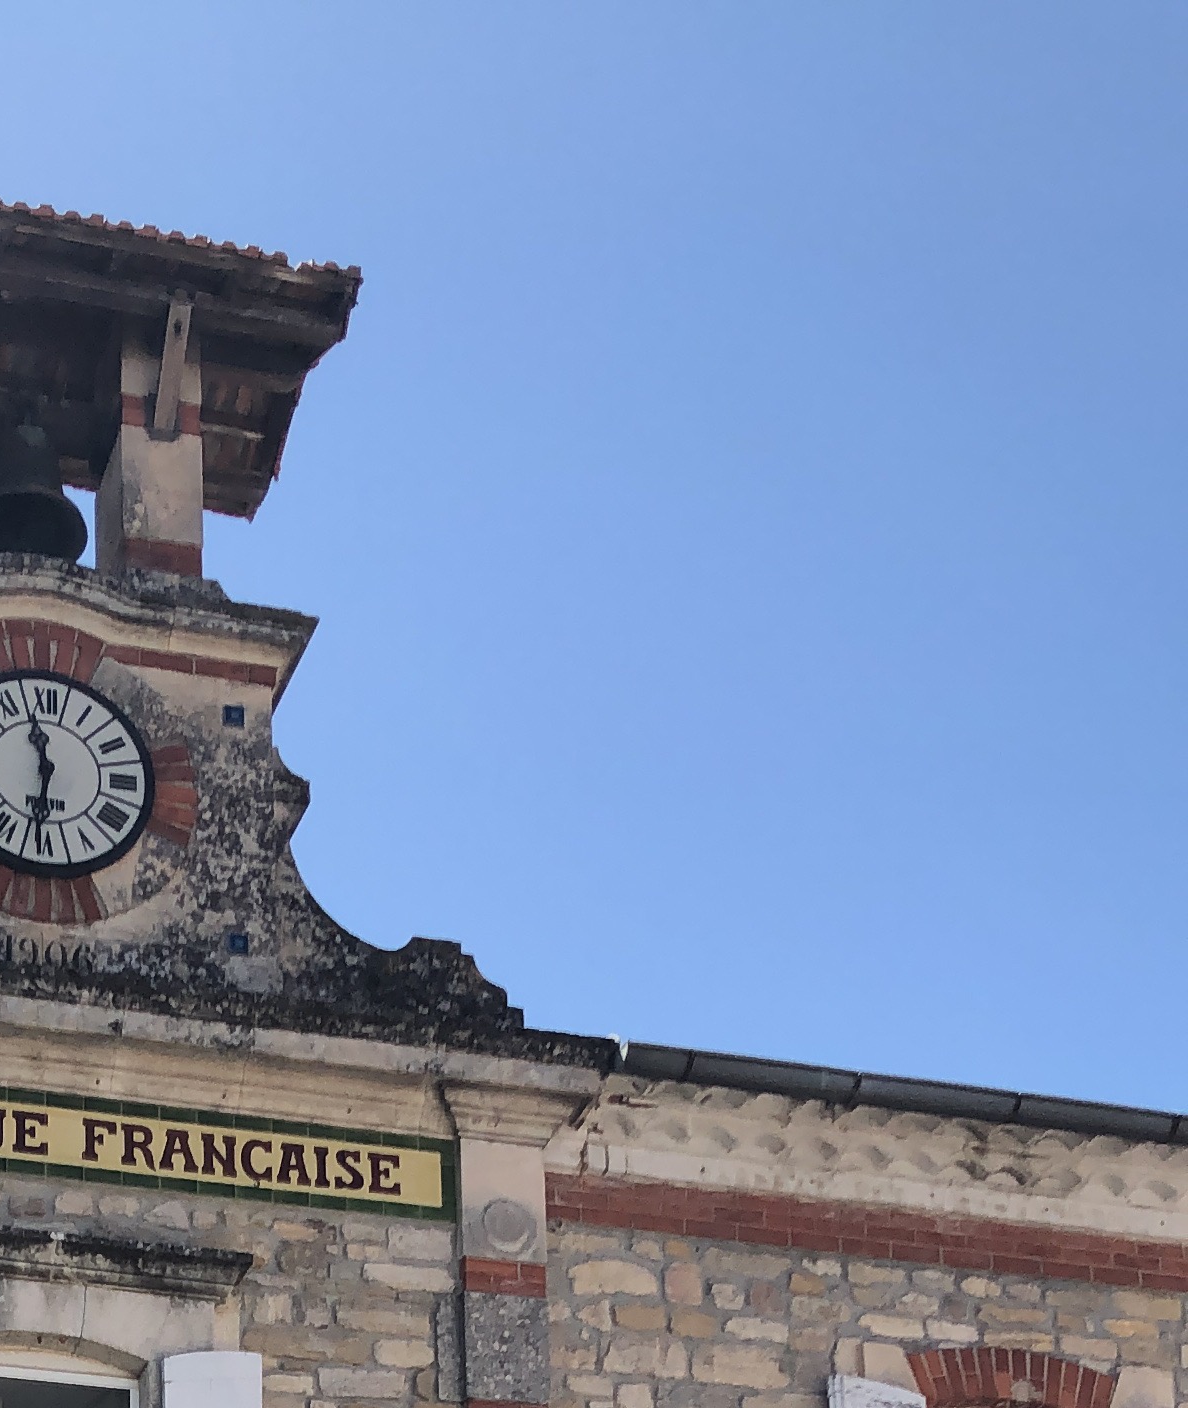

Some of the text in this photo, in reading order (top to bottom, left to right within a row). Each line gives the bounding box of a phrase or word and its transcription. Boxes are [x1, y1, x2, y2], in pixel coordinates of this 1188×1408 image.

[33, 686, 58, 716] XII
[98, 736, 126, 755] II
[109, 772, 137, 793] III
[77, 825, 96, 854] V
